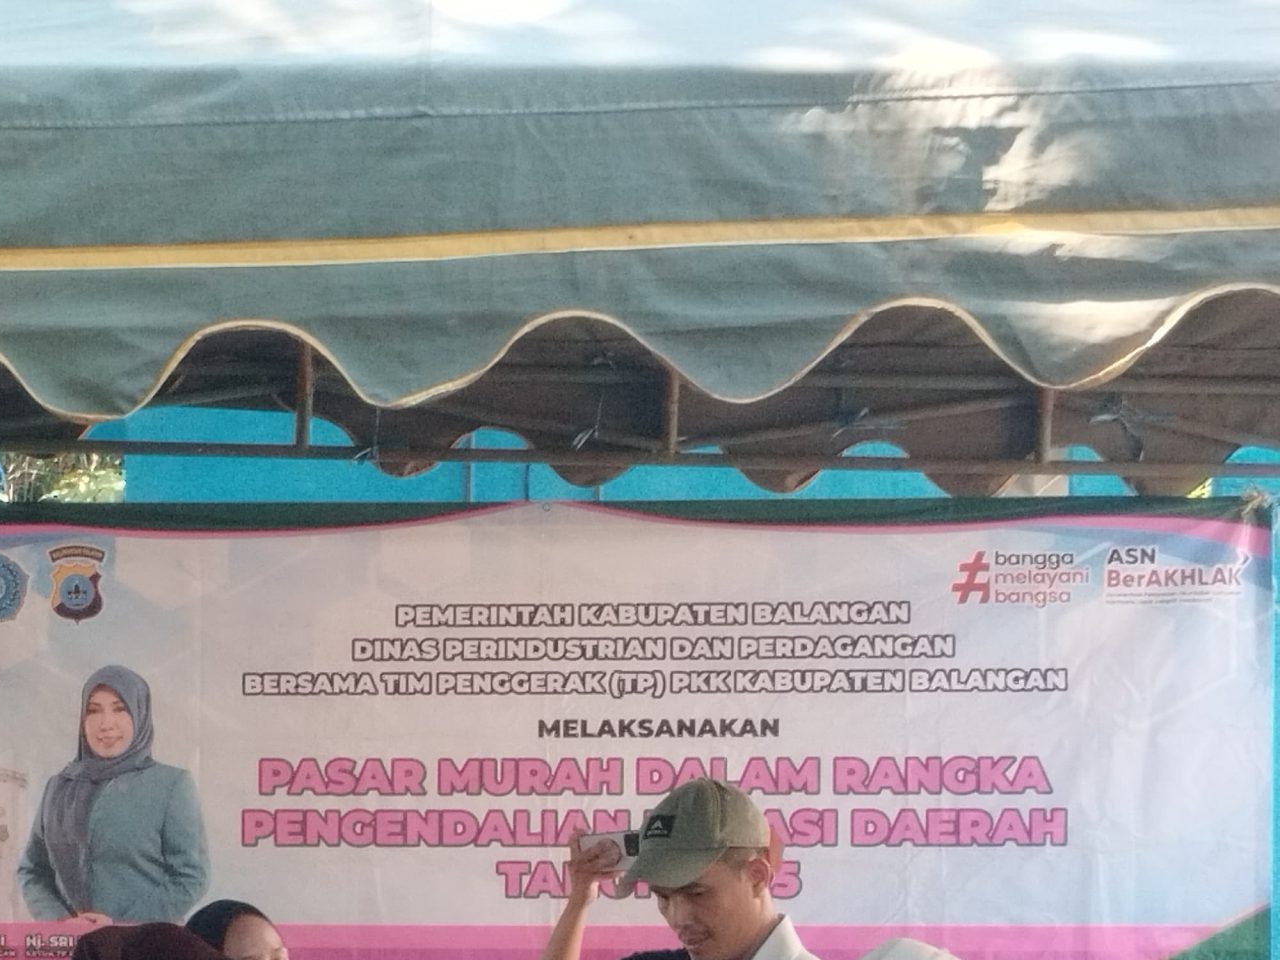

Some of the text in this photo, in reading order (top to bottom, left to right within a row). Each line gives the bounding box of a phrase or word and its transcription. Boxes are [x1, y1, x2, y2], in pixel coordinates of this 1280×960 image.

[994, 551, 1074, 569] bangga
[1107, 548, 1156, 565] ASN
[994, 568, 1089, 588] melayani
[1106, 567, 1241, 588] BerAKHLAK
[994, 588, 1072, 607] bangsa
[396, 601, 910, 627] PEMERINTAH KABUPATEN BALANGAN
[352, 634, 955, 661] DINAS PERINDUSTRIAN DAN PERDAGANGAN
[242, 668, 1068, 699] BERSAMA TIM PENGGERAK (TP) PKK KABUPATEN BALANGAN
[538, 718, 780, 738] MELAKSANAKAN
[258, 757, 426, 796] PASAR
[437, 757, 624, 796] MURAH
[833, 755, 1053, 795] RANGKA
[241, 808, 631, 848] PENGENDALIAN
[850, 807, 1068, 847] DAERAH
[49, 935, 74, 947] SRI
